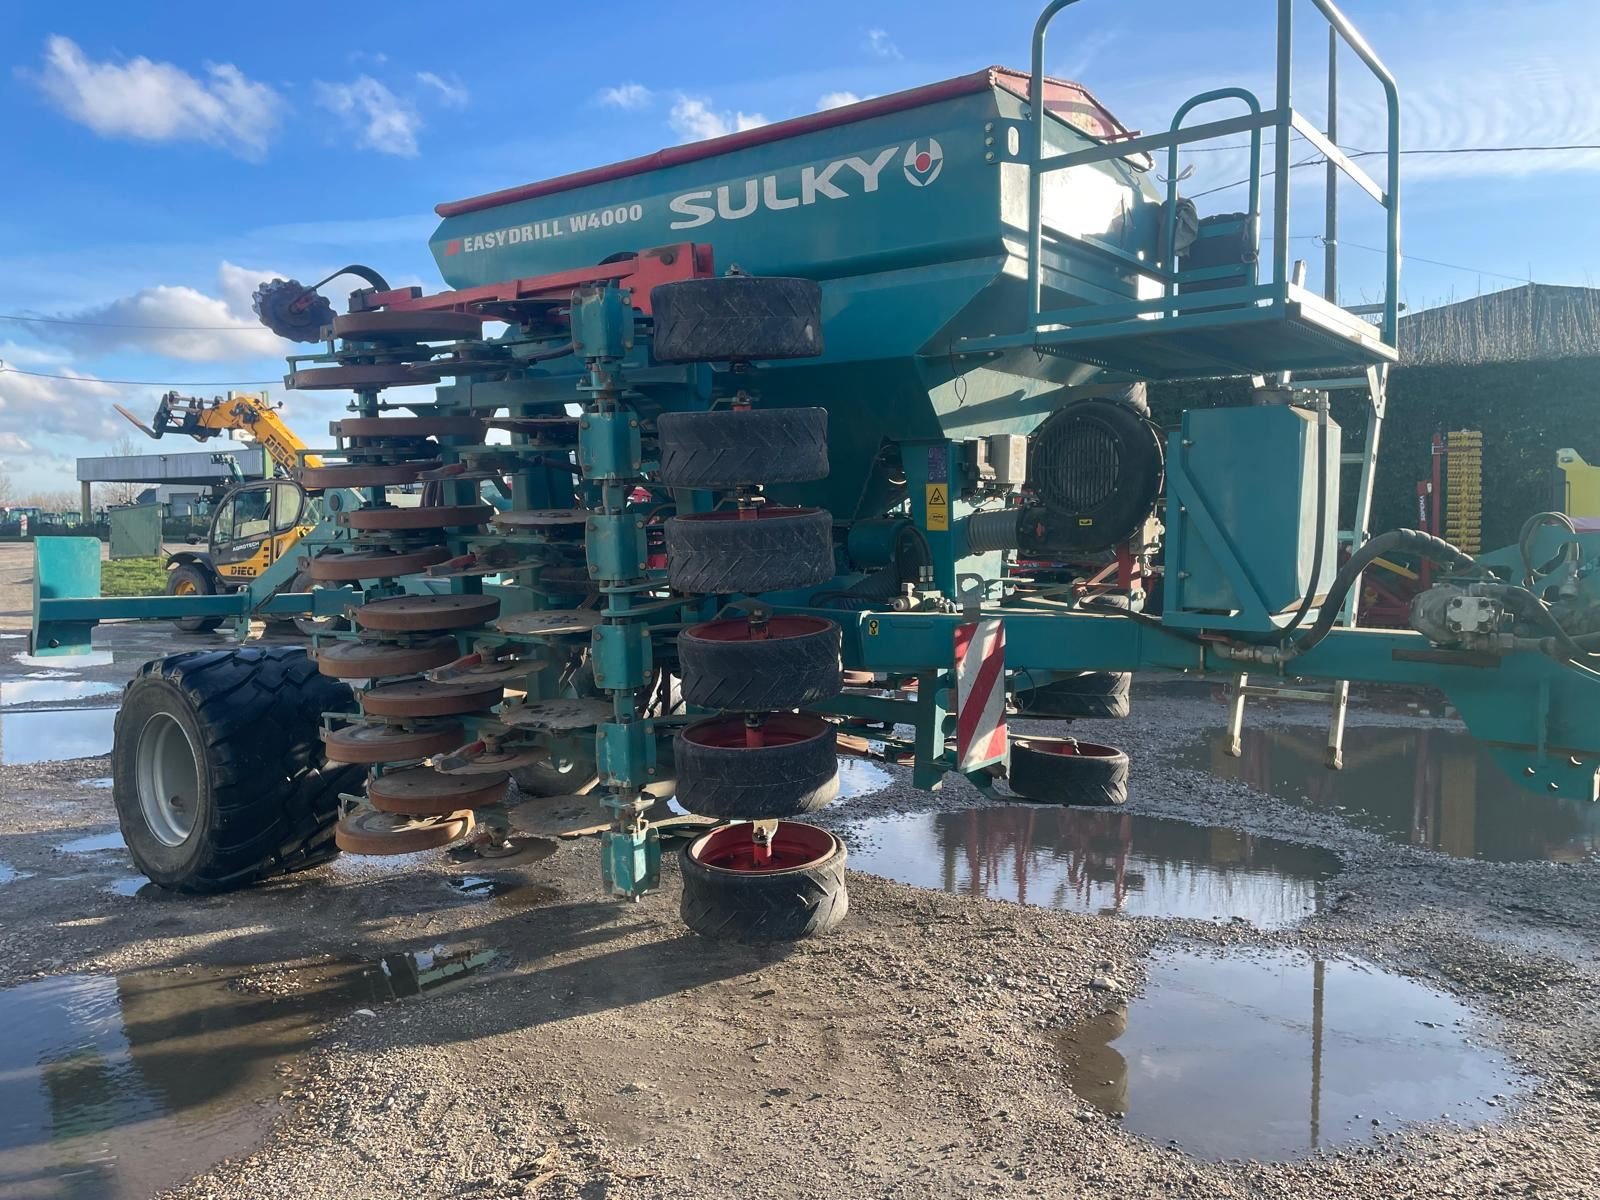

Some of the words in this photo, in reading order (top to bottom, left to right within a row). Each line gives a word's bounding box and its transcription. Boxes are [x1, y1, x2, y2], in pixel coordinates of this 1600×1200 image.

[669, 146, 899, 230] SULKY
[464, 219, 563, 252] EASYDRILL
[569, 204, 643, 233] W4000
[264, 434, 296, 469] DIEC
[232, 541, 260, 551] AGROTECH
